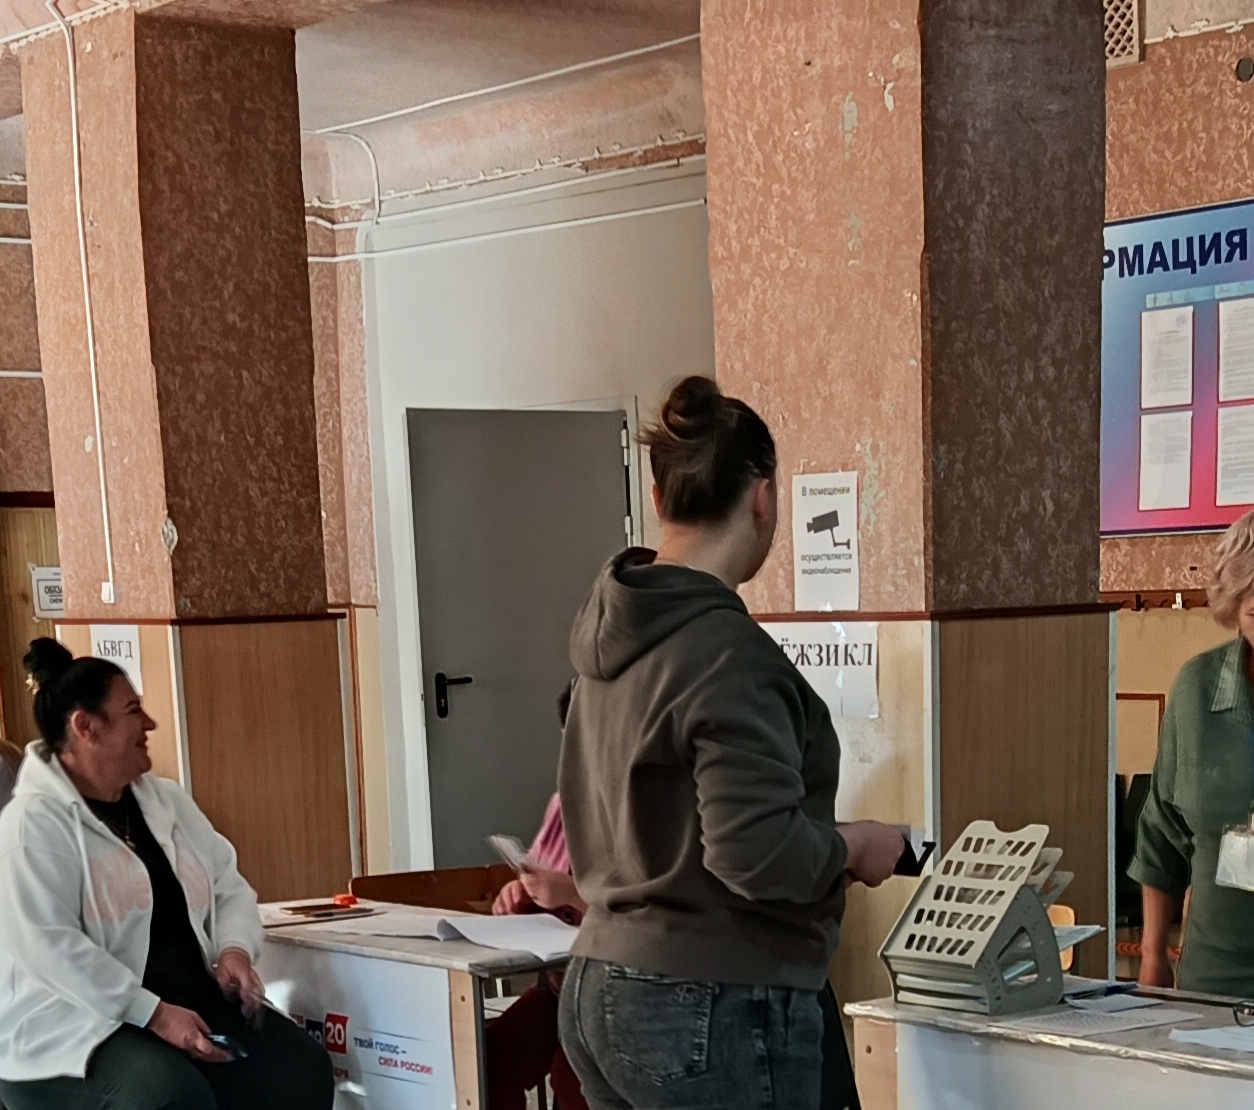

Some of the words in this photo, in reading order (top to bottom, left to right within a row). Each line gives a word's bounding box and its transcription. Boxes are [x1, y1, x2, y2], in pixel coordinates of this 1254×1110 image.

[95, 640, 134, 660] АБВГД
[325, 1021, 345, 1046] 20
[353, 1037, 374, 1050] ТВОЙ
[375, 1041, 400, 1055] ГОЛОС
